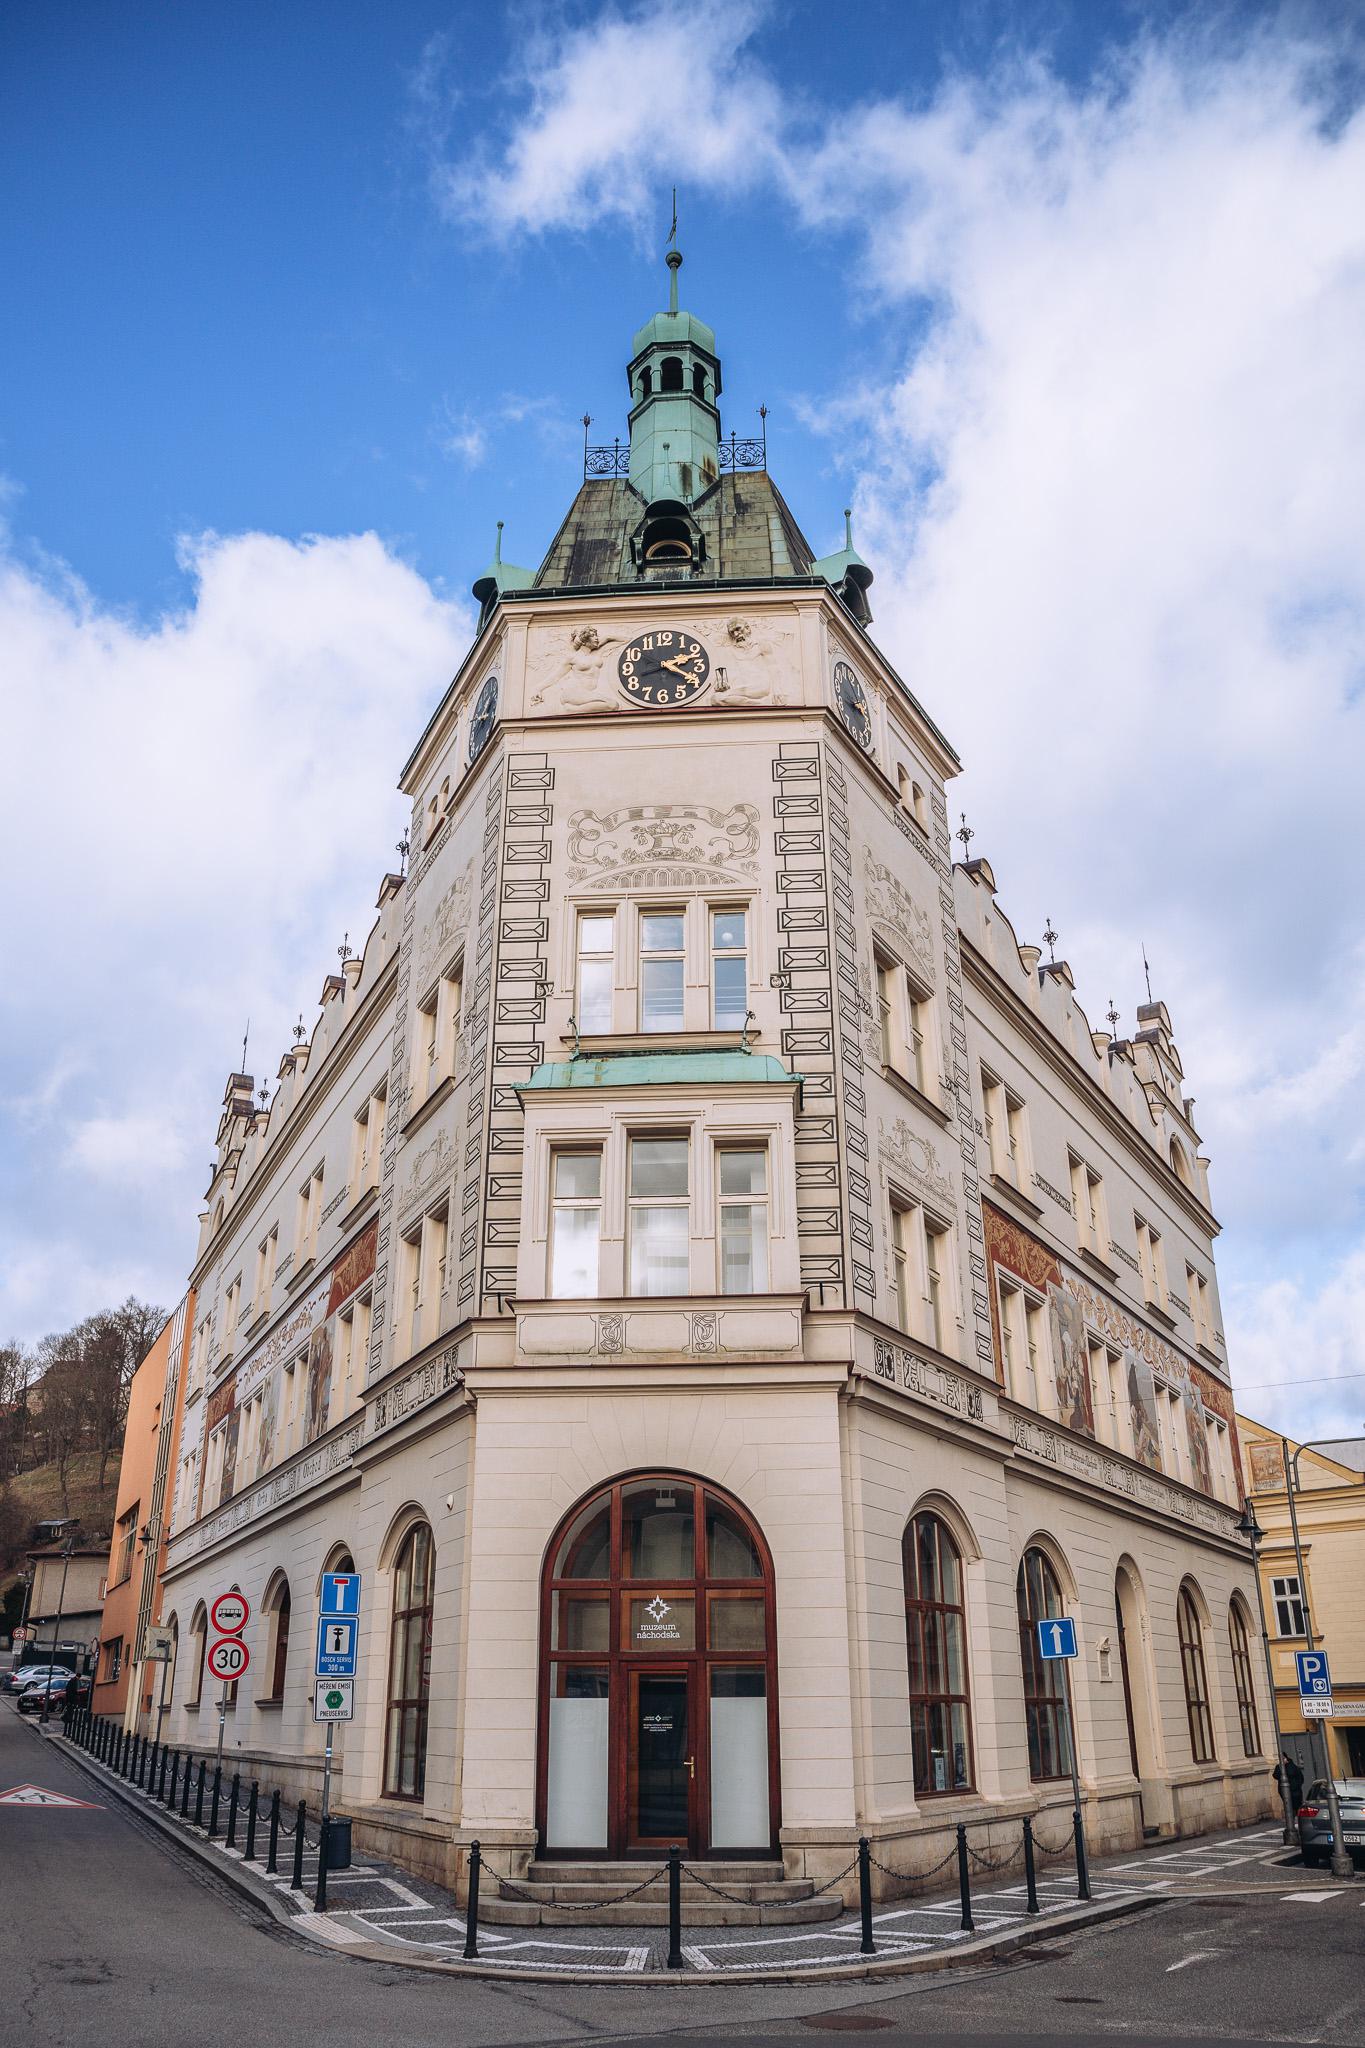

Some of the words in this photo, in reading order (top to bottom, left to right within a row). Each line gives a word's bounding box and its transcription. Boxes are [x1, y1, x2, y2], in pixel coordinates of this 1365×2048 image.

[642, 635, 654, 651] 11
[656, 632, 673, 646] 12
[679, 634, 686, 649] 1
[625, 647, 642, 662] 10
[689, 643, 701, 658] 2
[622, 661, 634, 676] 9
[693, 658, 706, 673] 3
[627, 676, 640, 690] 8
[641, 686, 653, 700] 7
[656, 689, 669, 703] 6
[674, 684, 687, 699] 5
[636, 1631, 681, 1639] náchodska
[216, 1649, 241, 1669] 30
[1302, 1656, 1321, 1683] P
